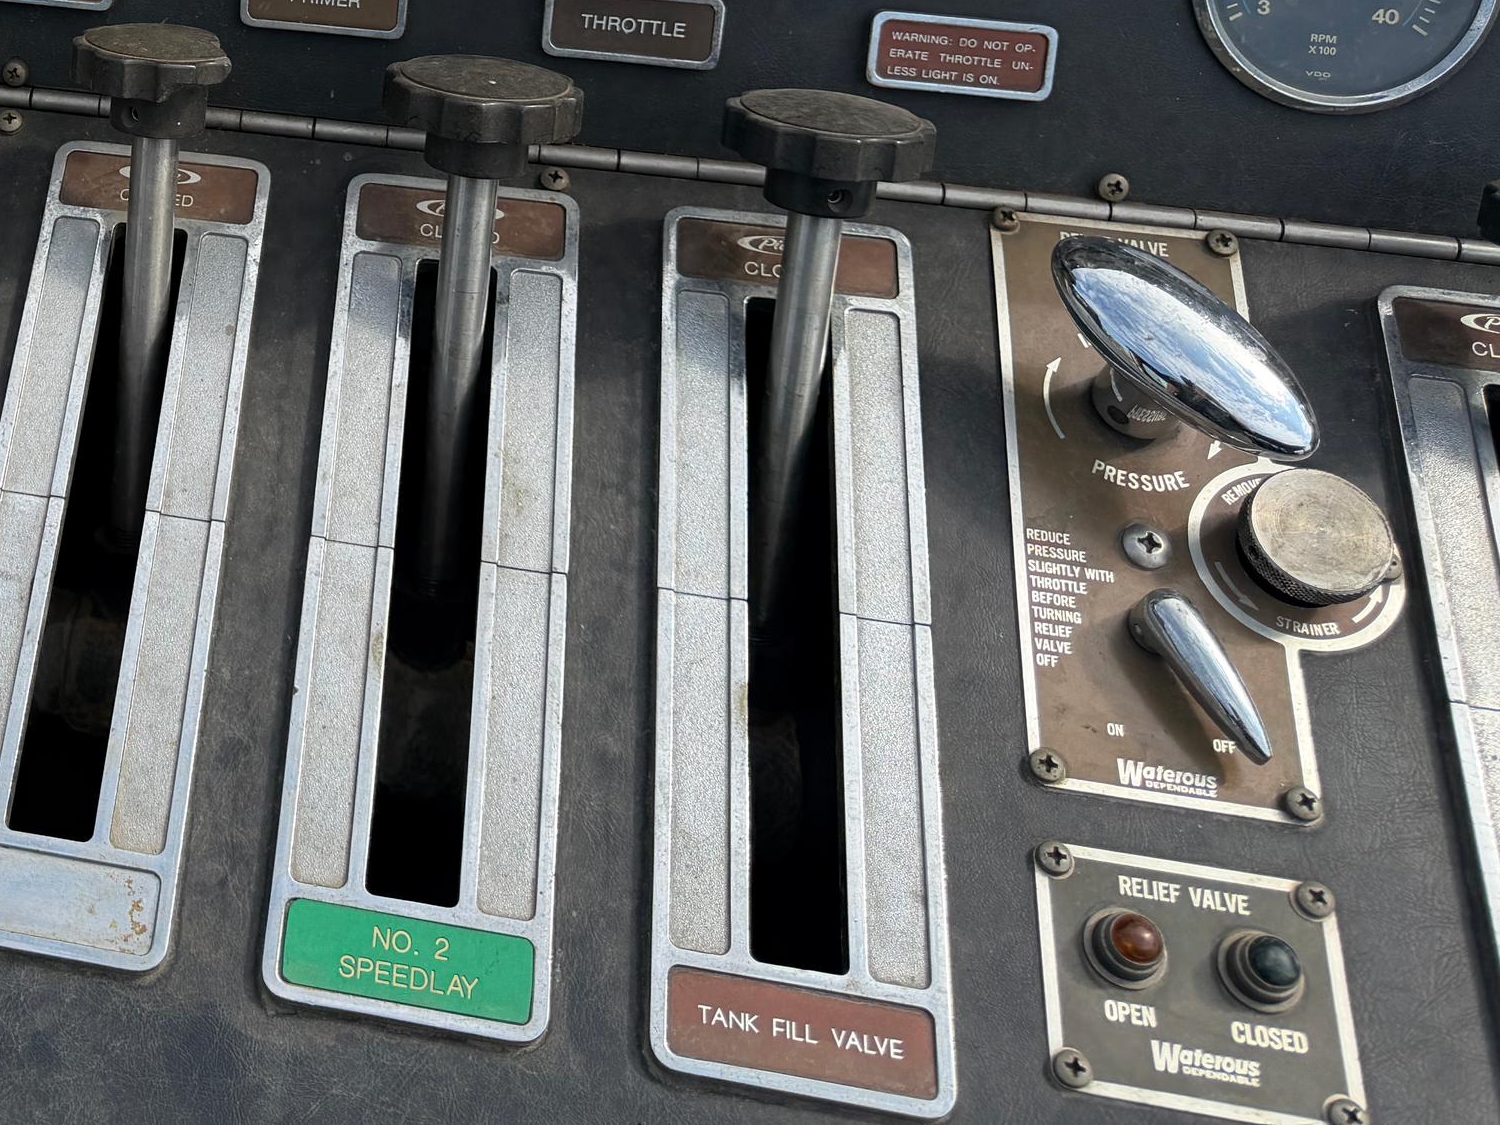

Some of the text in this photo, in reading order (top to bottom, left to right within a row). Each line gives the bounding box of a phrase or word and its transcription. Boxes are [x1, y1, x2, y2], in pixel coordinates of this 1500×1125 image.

[1257, 0, 1271, 15] 3
[1371, 8, 1400, 25] 40
[581, 12, 687, 39] THROTTLE
[892, 31, 1036, 53] WARNING: DO NOT OP-
[1310, 33, 1337, 44] RPM
[889, 48, 1034, 71] ERATE THROTTLE UN-
[887, 65, 1000, 86] LESS LIGHT IS ON.
[1092, 459, 1190, 492] PRESSURE
[1026, 528, 1071, 546] REDUCE
[1026, 543, 1087, 563] PRESSURE
[1027, 559, 1115, 583] SLIGHTLY WITH
[1029, 574, 1088, 595] THROTTLE
[1031, 590, 1076, 608] BEFORE
[1031, 605, 1082, 624] TURNING
[1034, 621, 1073, 638] RELIEF
[1276, 615, 1341, 637] STRAINER
[1034, 637, 1073, 654] VALVE
[1036, 653, 1059, 668] OFF
[1107, 722, 1124, 737] ON
[1212, 738, 1237, 754] OFF
[1116, 757, 1218, 790] Waterous
[1145, 780, 1218, 798] DEPENDABLE
[1118, 875, 1251, 916] RELIEF VALVE
[371, 926, 451, 961] NO. 2
[338, 955, 481, 1001] SPEEDLAY
[1104, 999, 1157, 1028] OPEN
[698, 1004, 905, 1060] TANK FILL VALVE
[1231, 1021, 1309, 1054] CLOSED
[1151, 1039, 1261, 1078] Waterous
[1182, 1065, 1261, 1087] DEPENDABLE
